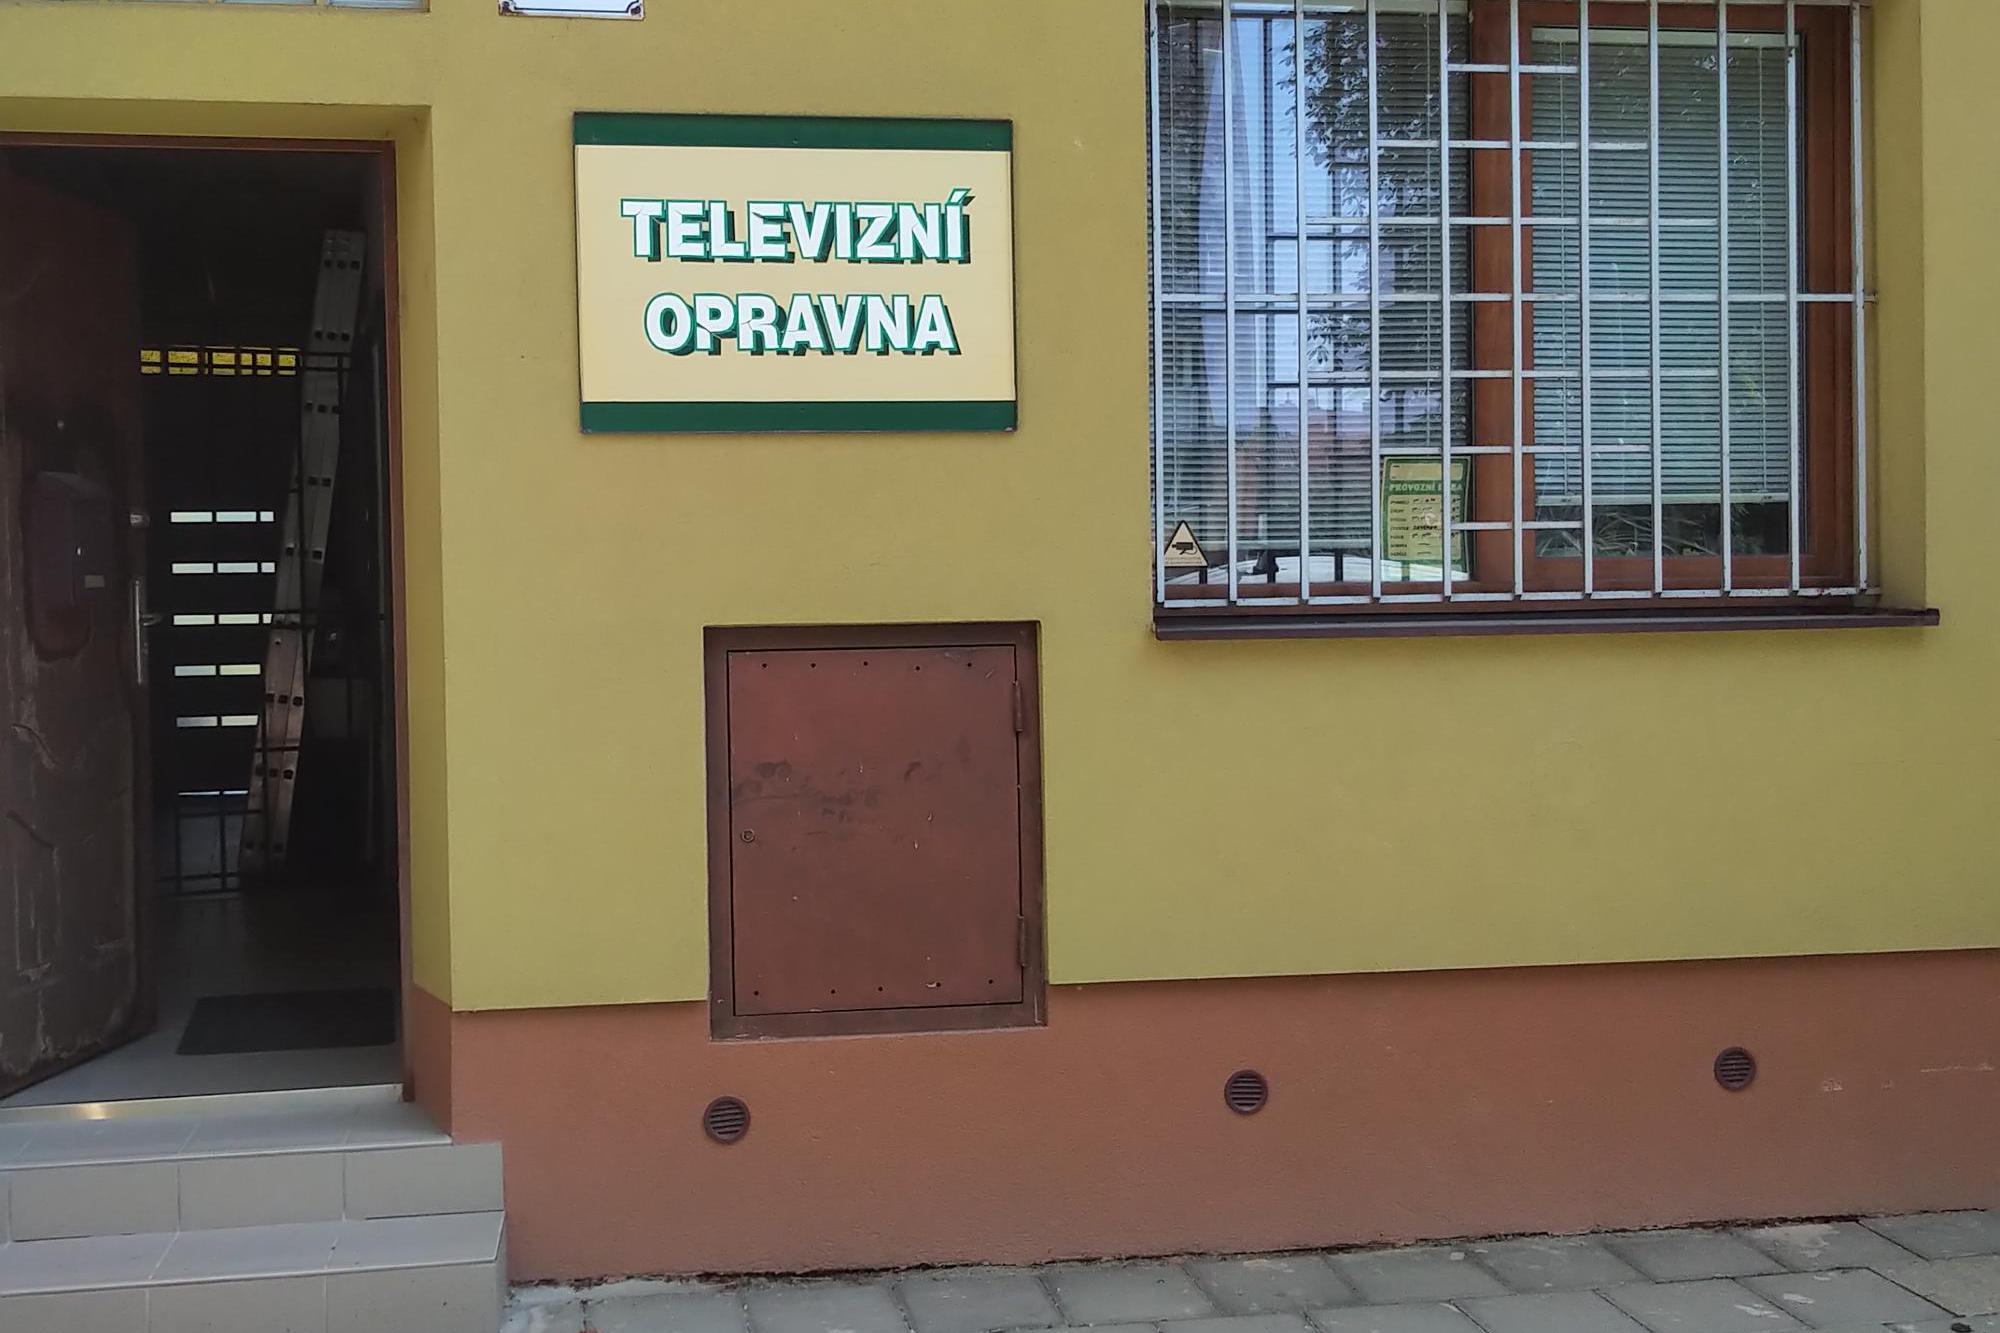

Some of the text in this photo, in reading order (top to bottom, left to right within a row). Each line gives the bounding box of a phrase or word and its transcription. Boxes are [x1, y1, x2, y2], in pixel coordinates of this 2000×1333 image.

[621, 188, 974, 264] TELEVIZNÍ
[644, 293, 962, 356] OPRAVNA
[1389, 482, 1436, 492] PROVOZNÍ
